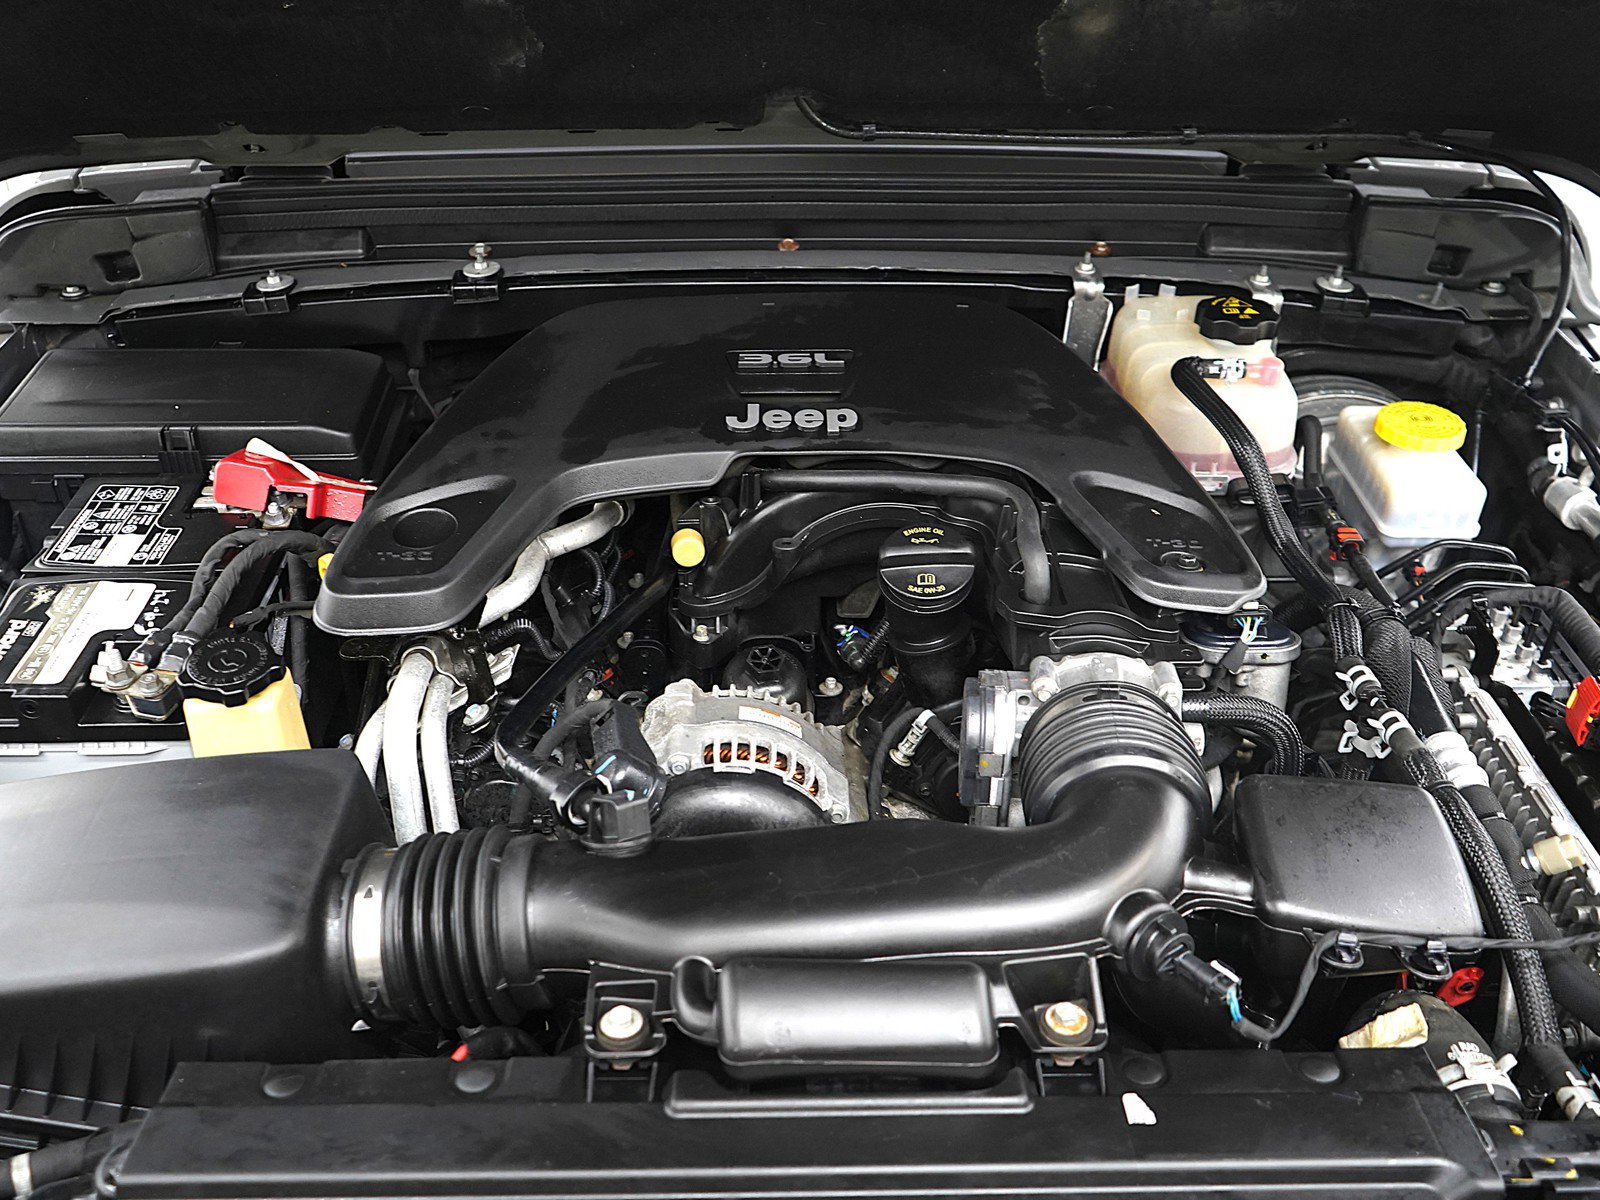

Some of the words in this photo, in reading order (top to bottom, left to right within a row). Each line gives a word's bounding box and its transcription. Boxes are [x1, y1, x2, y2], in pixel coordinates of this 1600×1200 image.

[738, 353, 845, 368] 3.6L
[725, 403, 858, 435] Jeep
[903, 527, 932, 537] ENGINE
[933, 527, 945, 536] OIL
[907, 585, 923, 593] SAE
[924, 585, 946, 594] 0W-20
